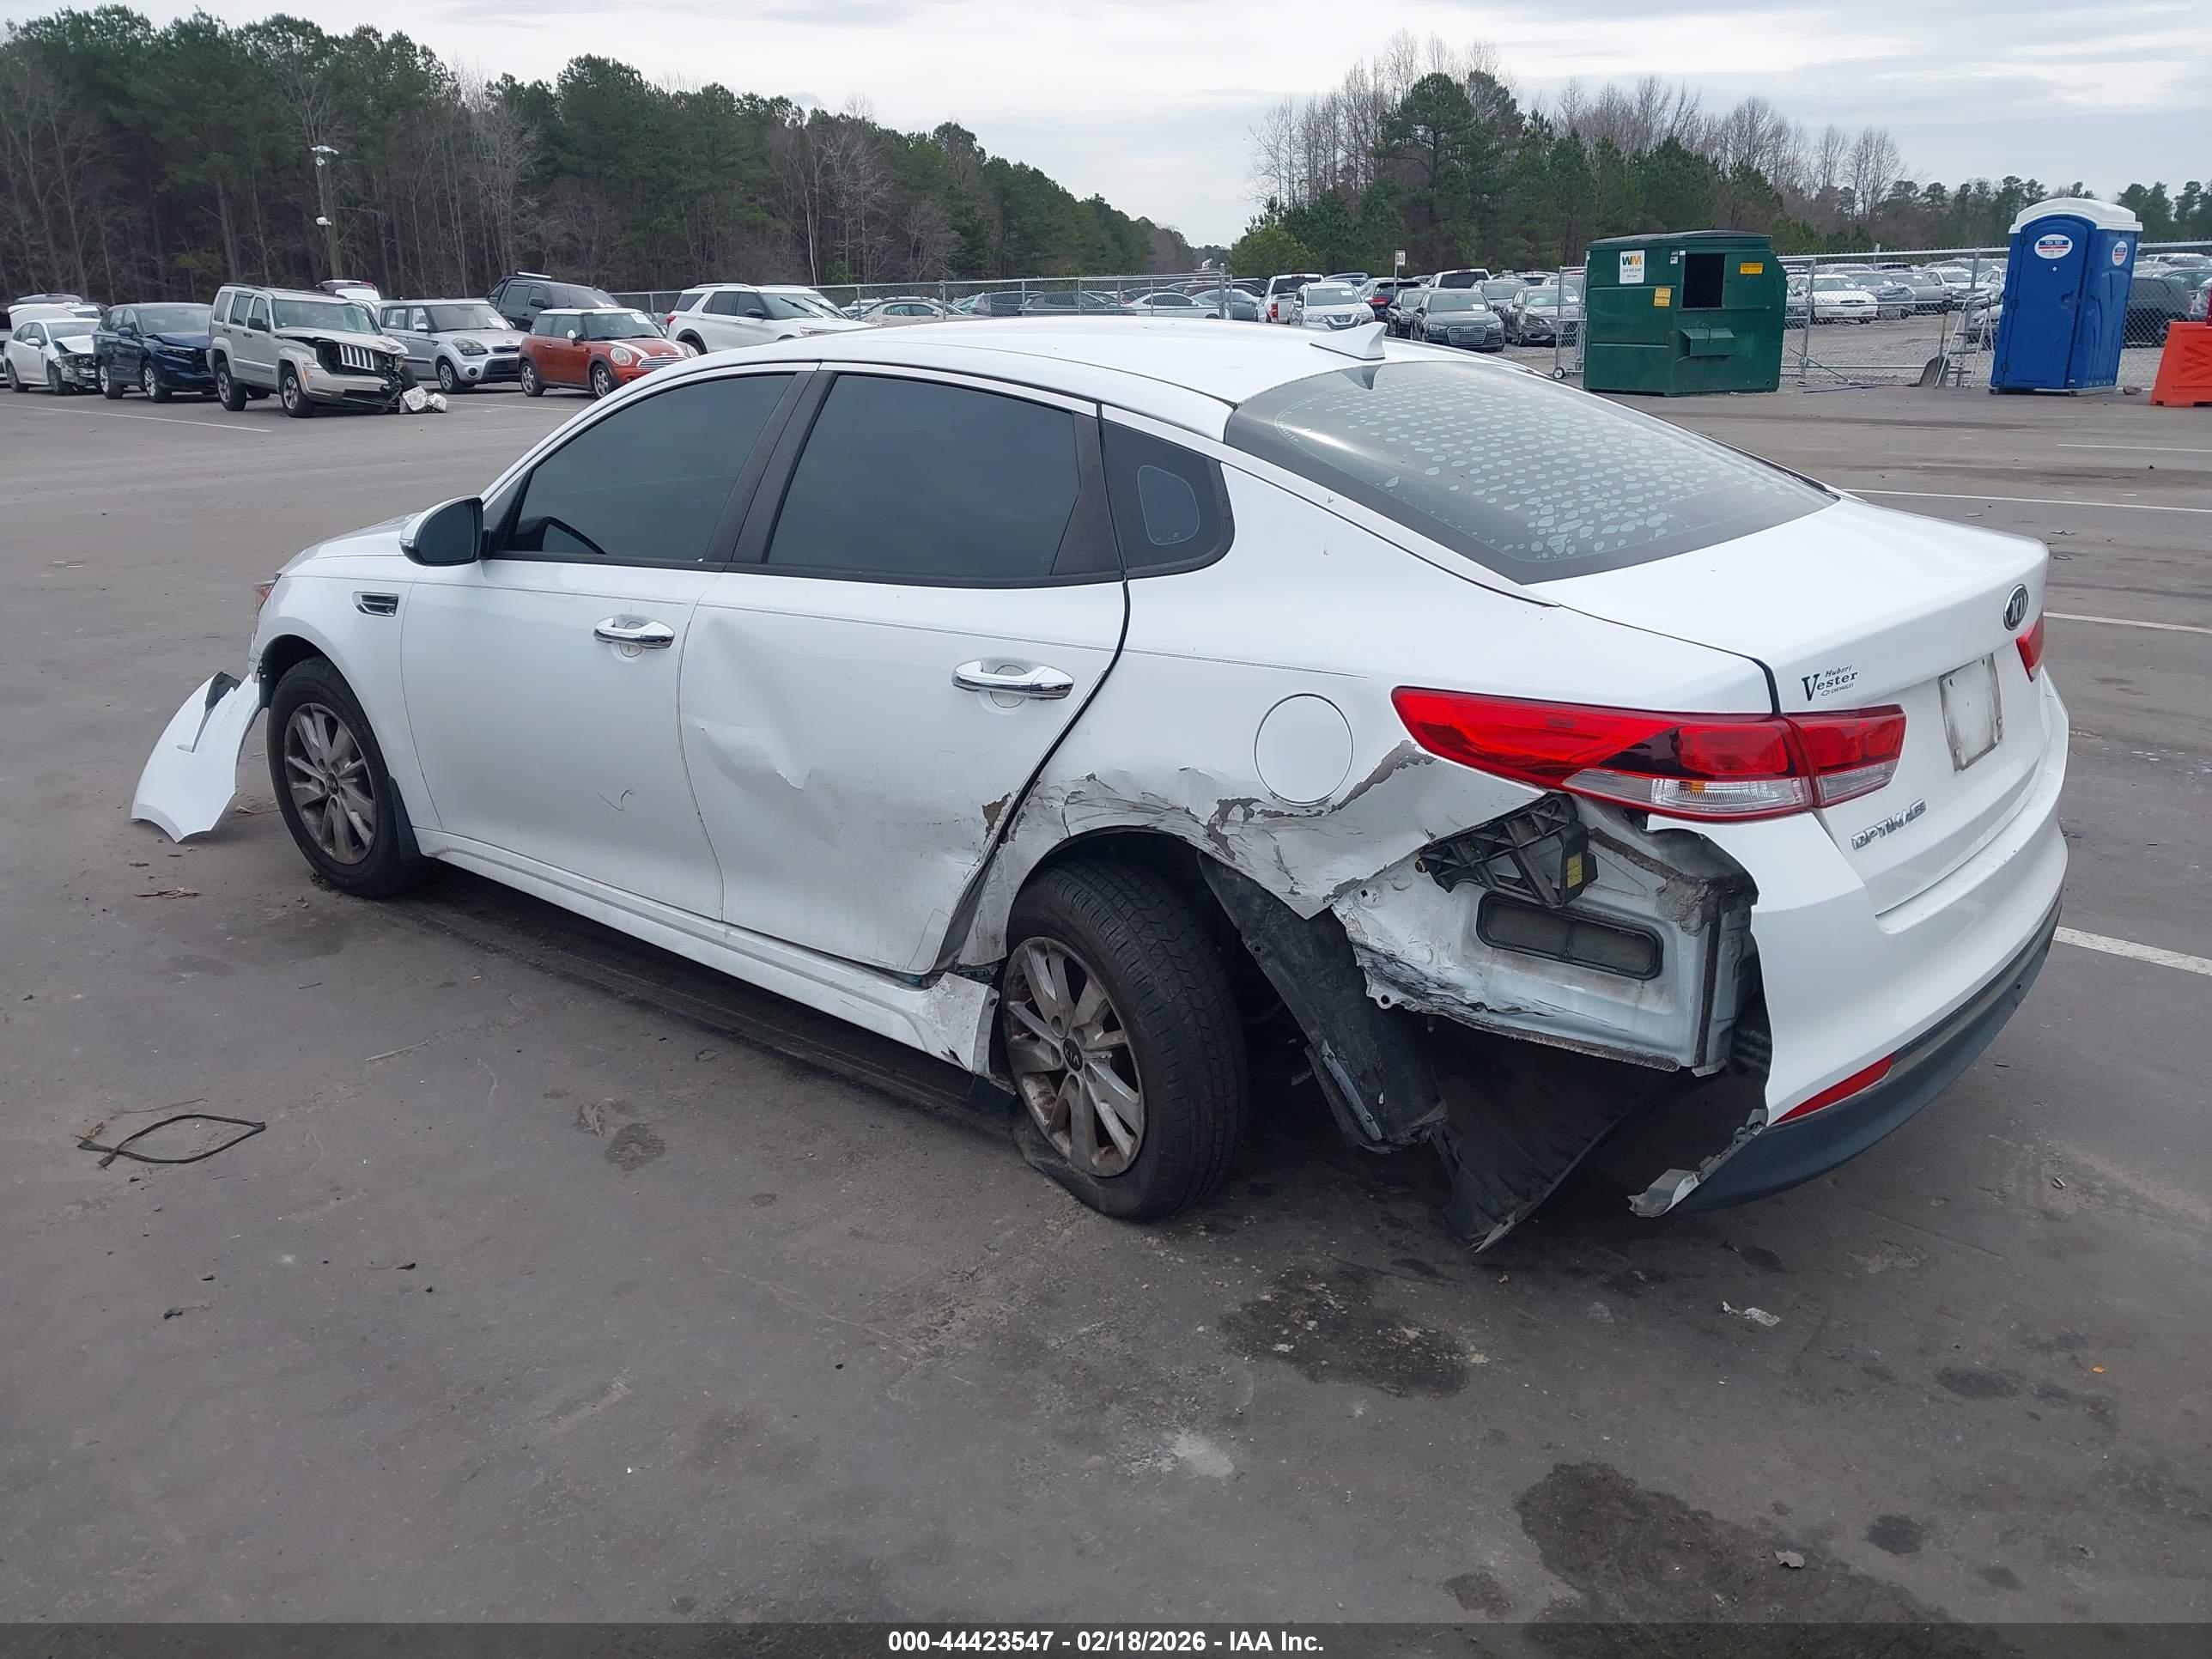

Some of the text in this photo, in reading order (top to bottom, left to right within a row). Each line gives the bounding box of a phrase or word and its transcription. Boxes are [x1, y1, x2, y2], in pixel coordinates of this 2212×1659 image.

[1622, 255, 1642, 265] WM
[1825, 665, 1852, 678] Hubert
[1802, 672, 1858, 701] Vester
[1851, 810, 1911, 850] OPTIMA
[1064, 1046, 1080, 1066] KIA
